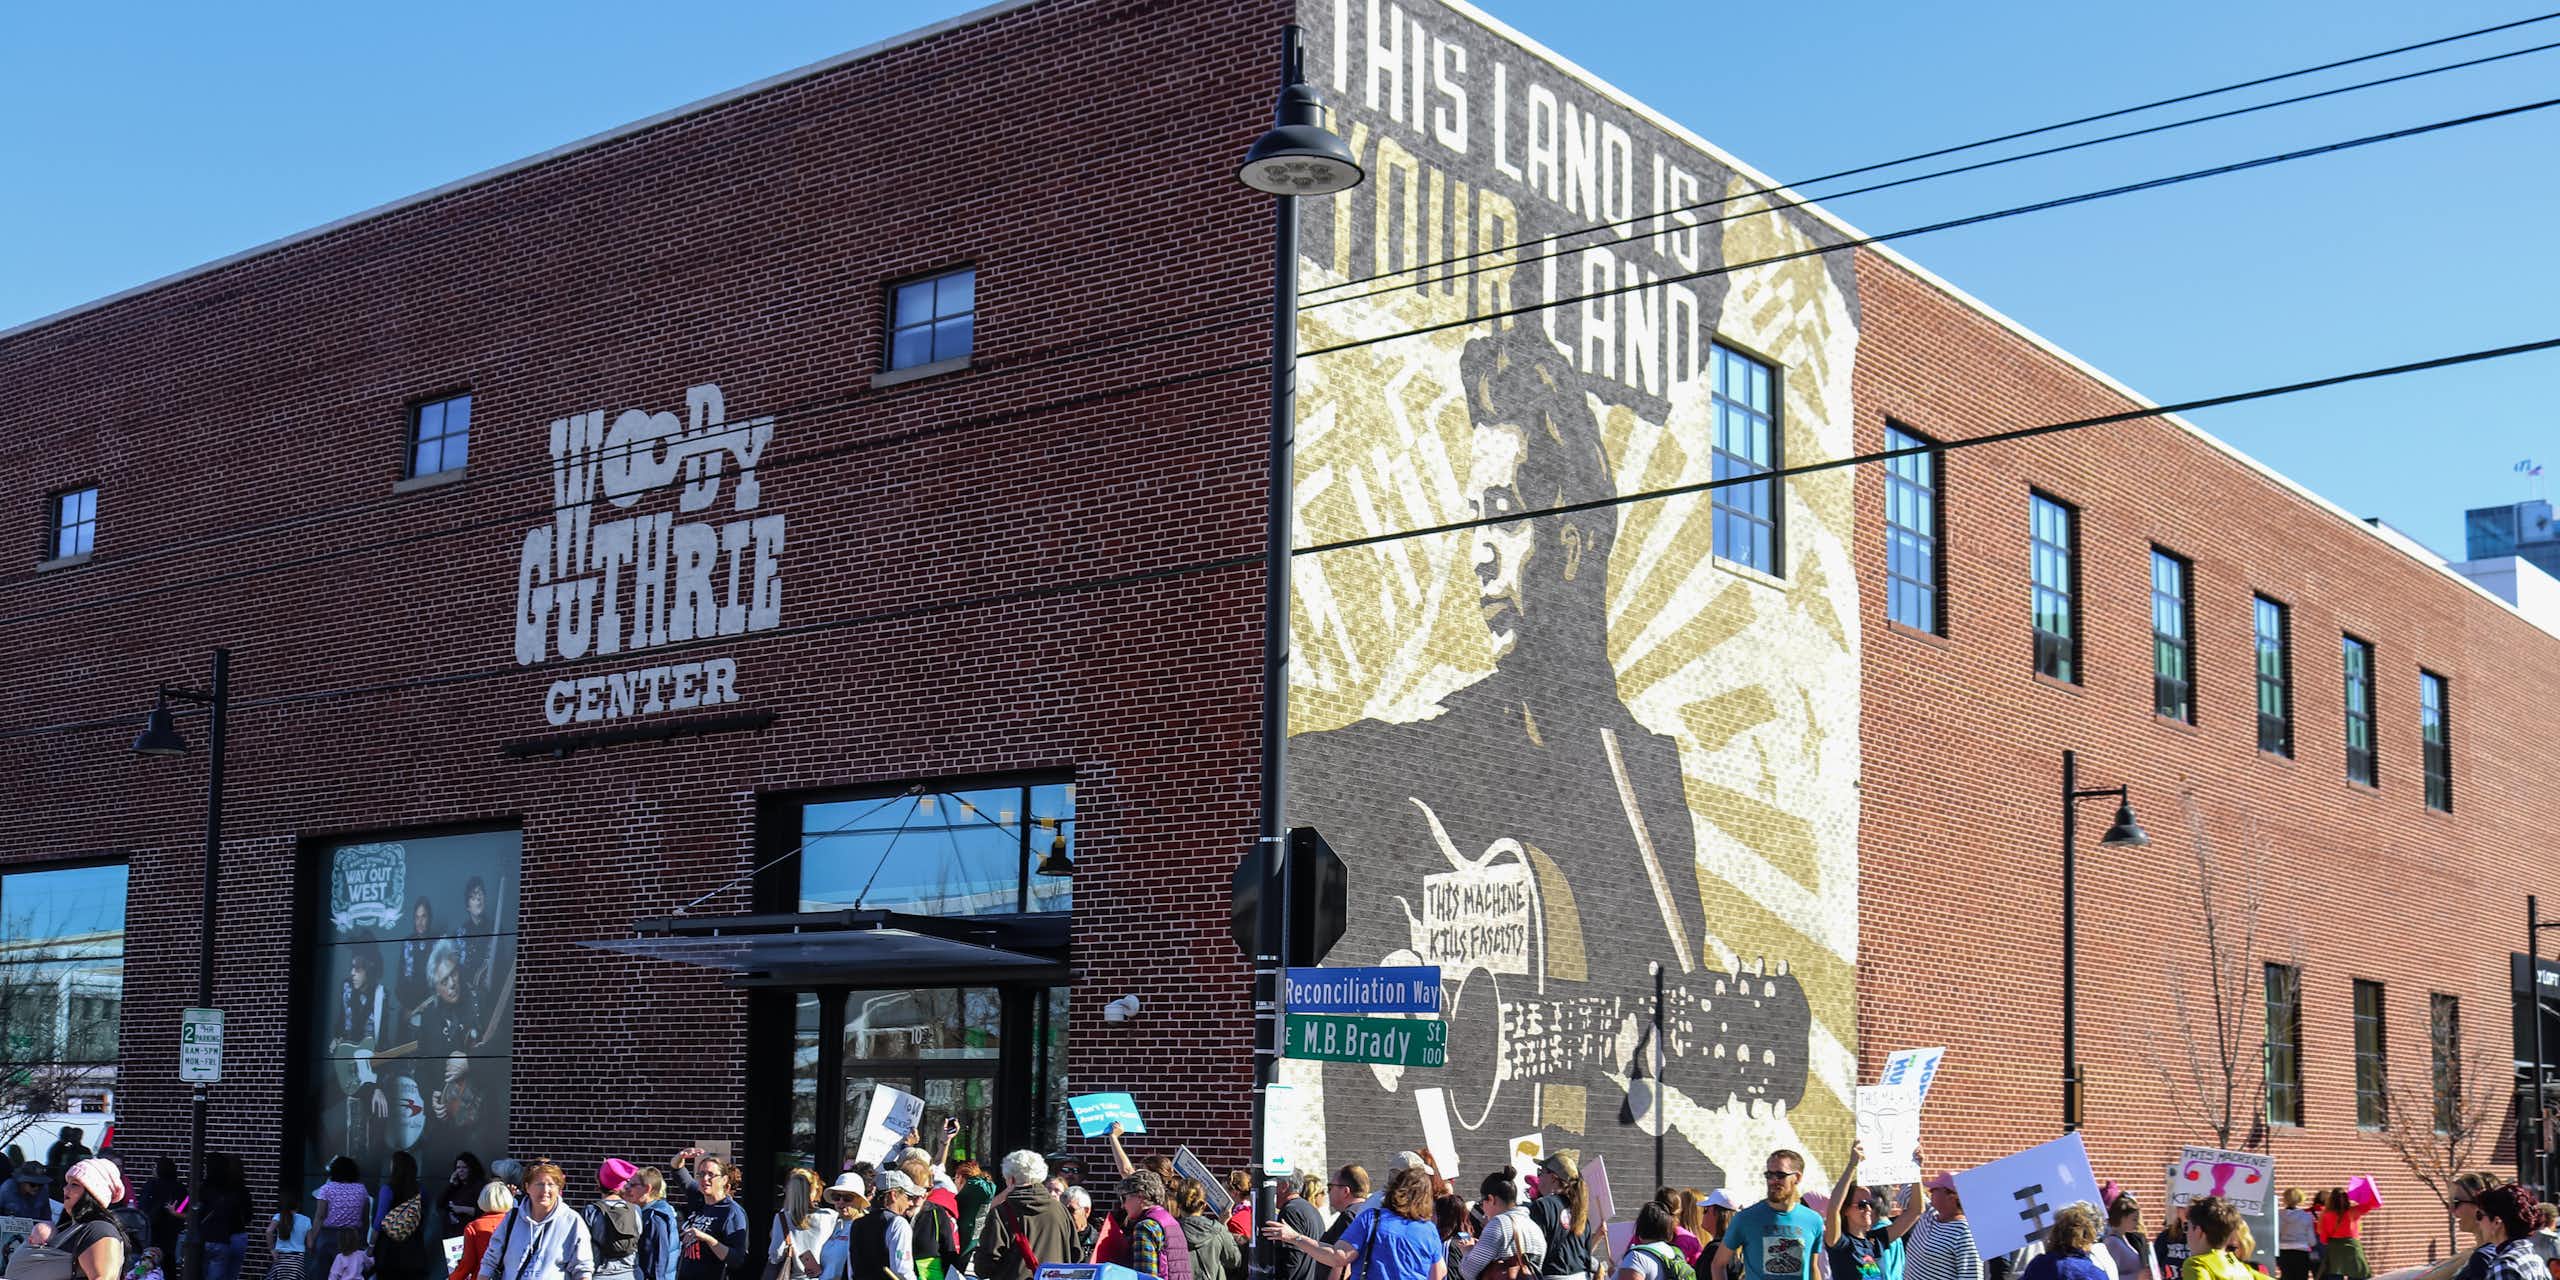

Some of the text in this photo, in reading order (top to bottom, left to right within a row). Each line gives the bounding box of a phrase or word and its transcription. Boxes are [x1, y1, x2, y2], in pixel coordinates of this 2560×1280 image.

[1334, 0, 1698, 273] THIS LAND IS
[1324, 105, 1699, 396] YOUR LAND
[550, 383, 775, 578] WOODY
[514, 511, 786, 666] GUTHRIE
[544, 656, 741, 726] CENTER
[345, 867, 392, 884] WAY OUT
[348, 883, 388, 902] WEST
[1426, 880, 1526, 922] THIS MACHINE
[1429, 923, 1525, 961] KILLS FASCISTS
[1284, 976, 1440, 1009] Reconciliation Way
[184, 1026, 194, 1041] 2
[1284, 1028, 1292, 1047] E
[1427, 1022, 1443, 1043] St
[1422, 1047, 1443, 1066] 100
[2184, 1149, 2215, 1161] THIS
